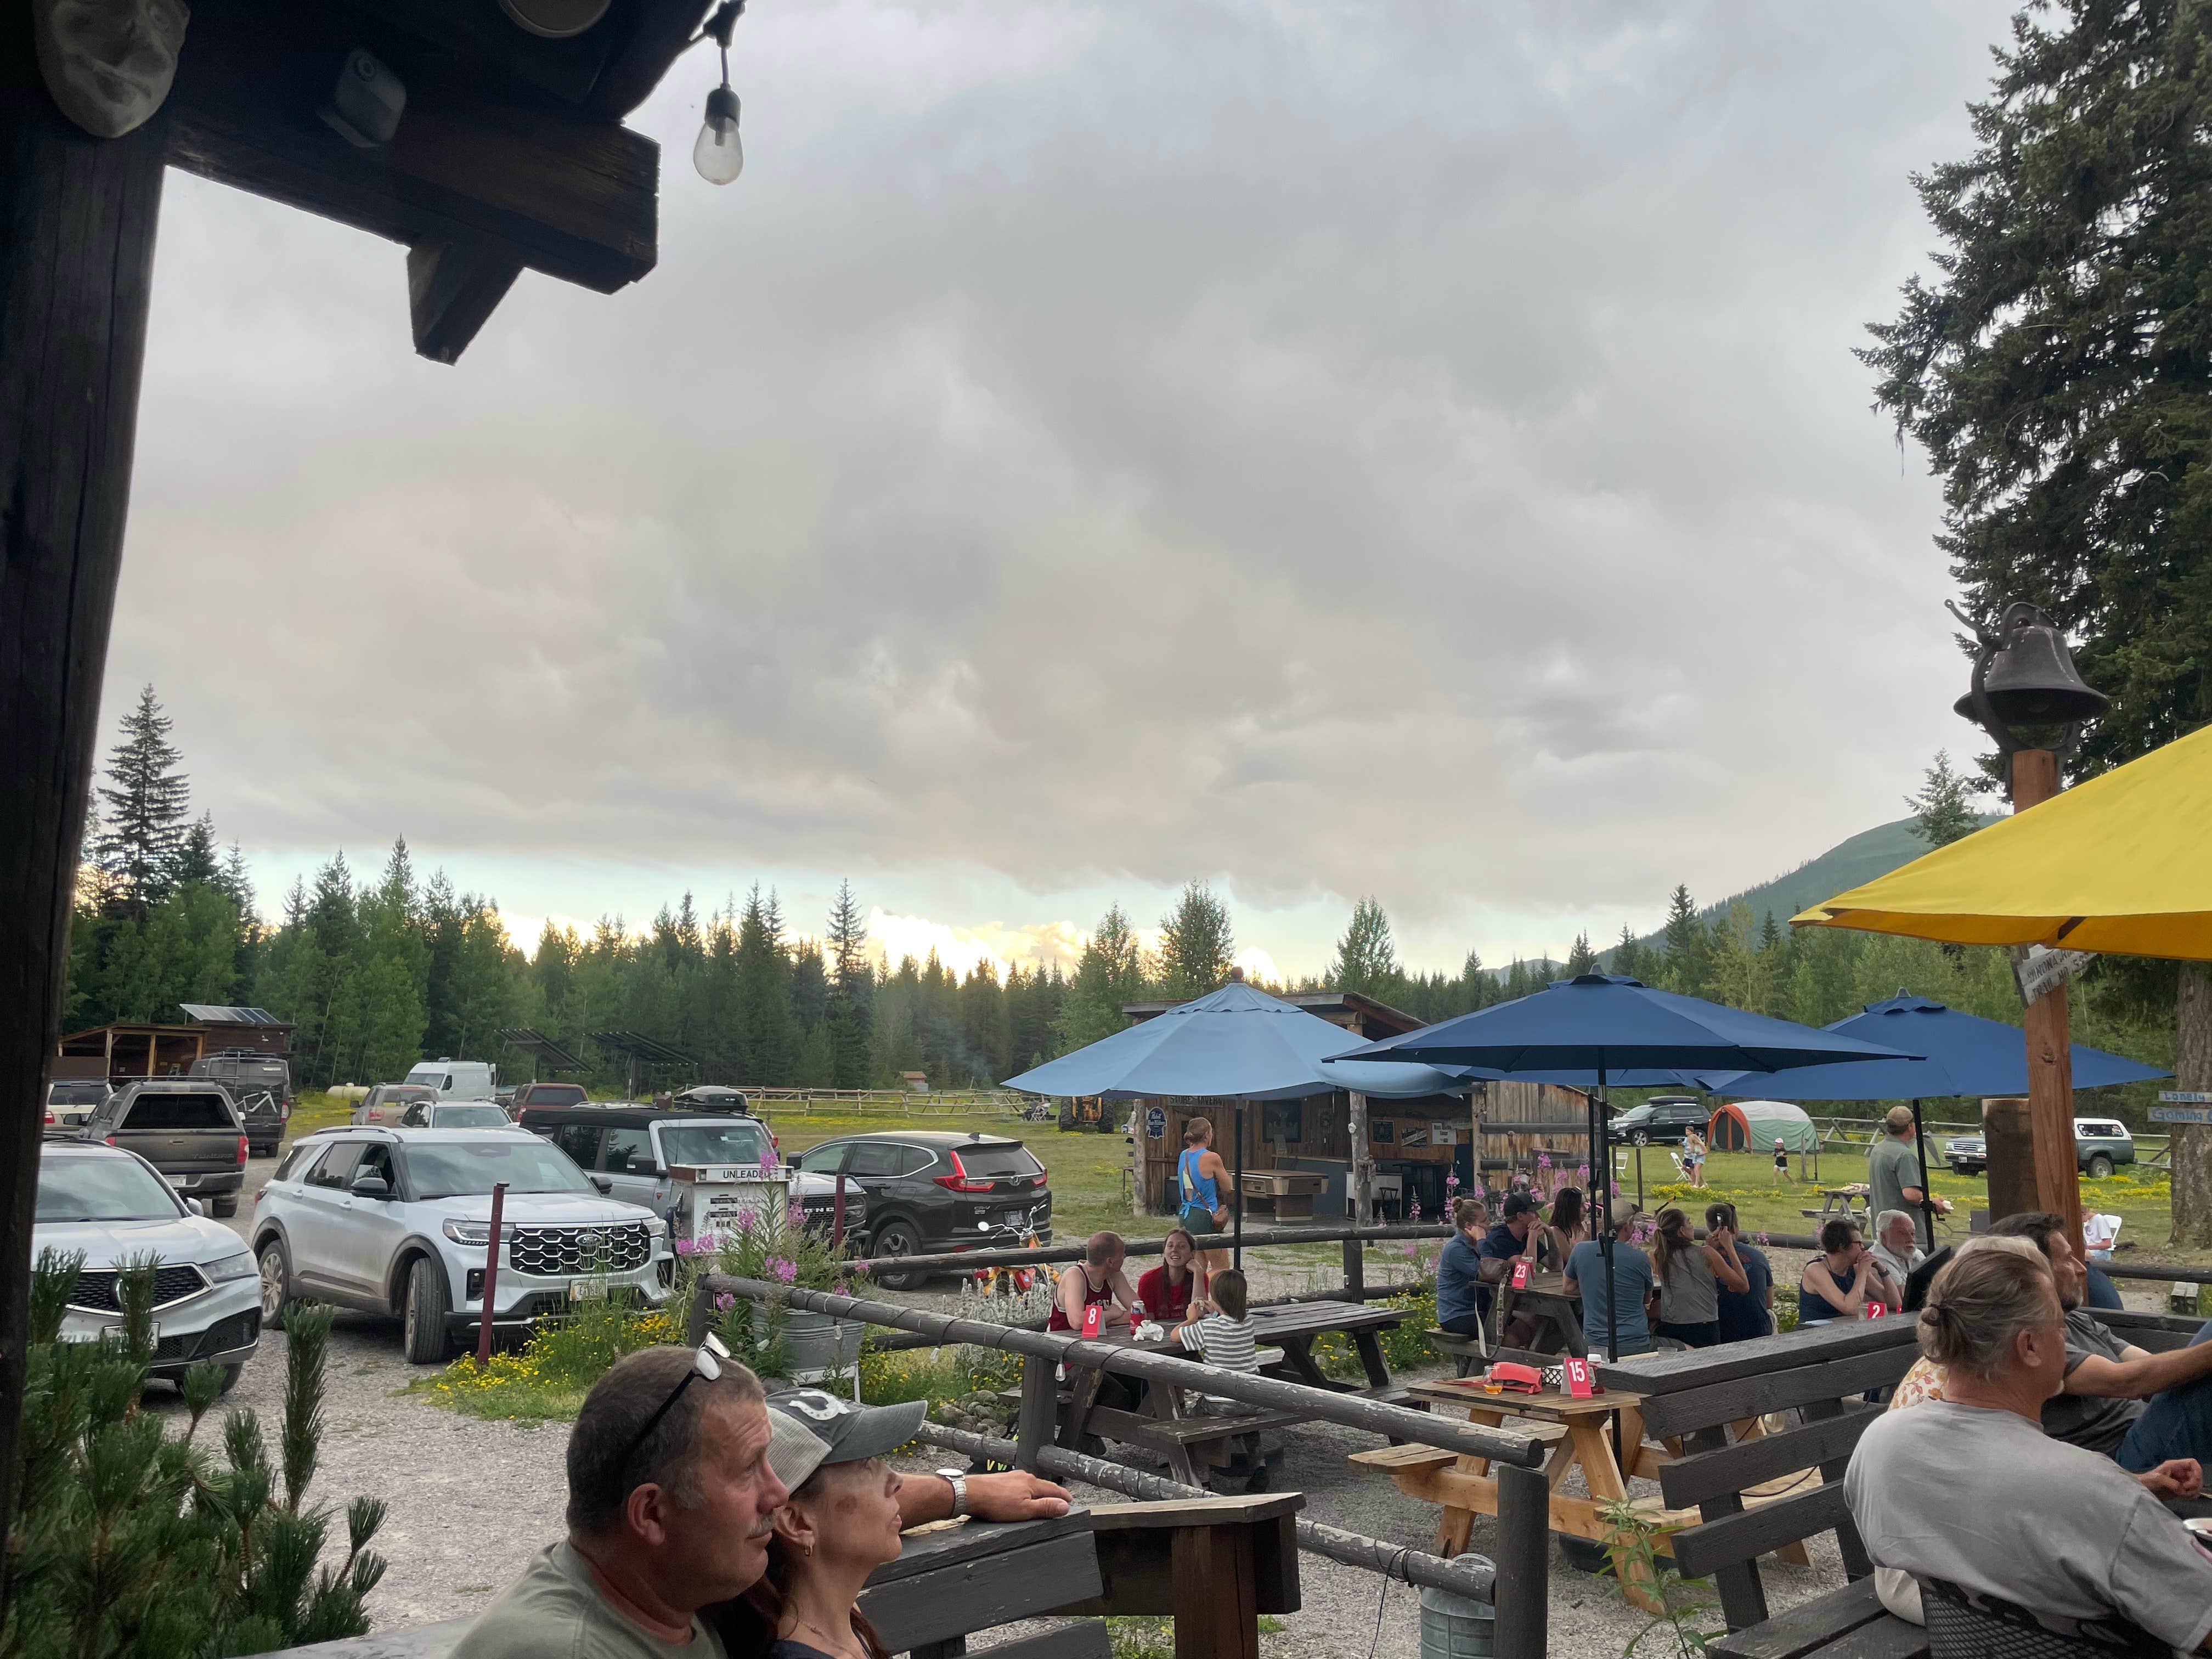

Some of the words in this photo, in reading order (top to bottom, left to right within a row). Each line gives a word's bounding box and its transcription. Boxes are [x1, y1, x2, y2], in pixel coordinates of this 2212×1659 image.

[1515, 1263, 1527, 1279] 23
[1088, 1307, 1097, 1325] 8
[1569, 1361, 1585, 1382] 15
